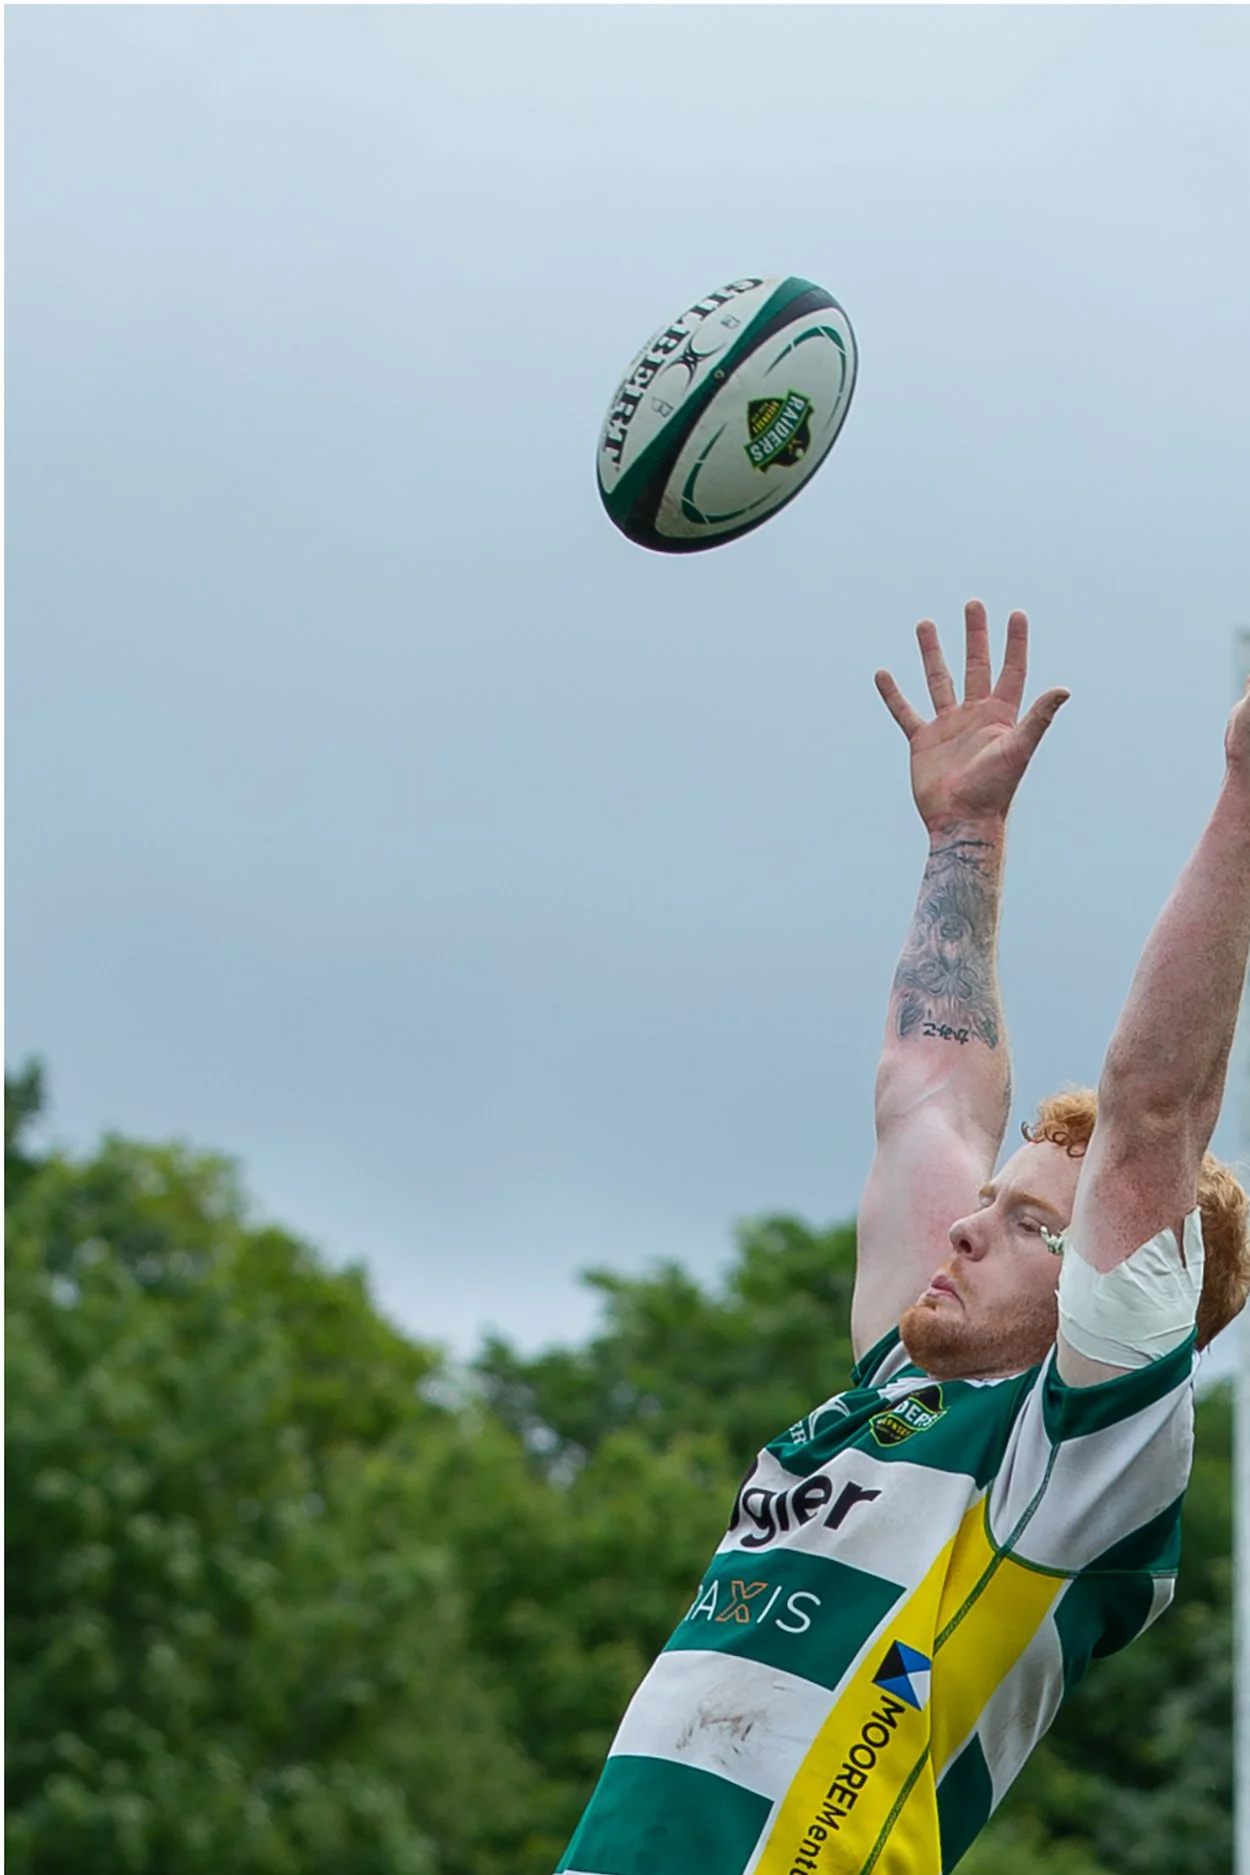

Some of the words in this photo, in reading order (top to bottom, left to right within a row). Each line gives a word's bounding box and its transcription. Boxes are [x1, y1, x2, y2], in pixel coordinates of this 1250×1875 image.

[602, 277, 764, 465] GILBERT
[750, 395, 806, 461] RAIDERS
[685, 1579, 821, 1633] AXIS
